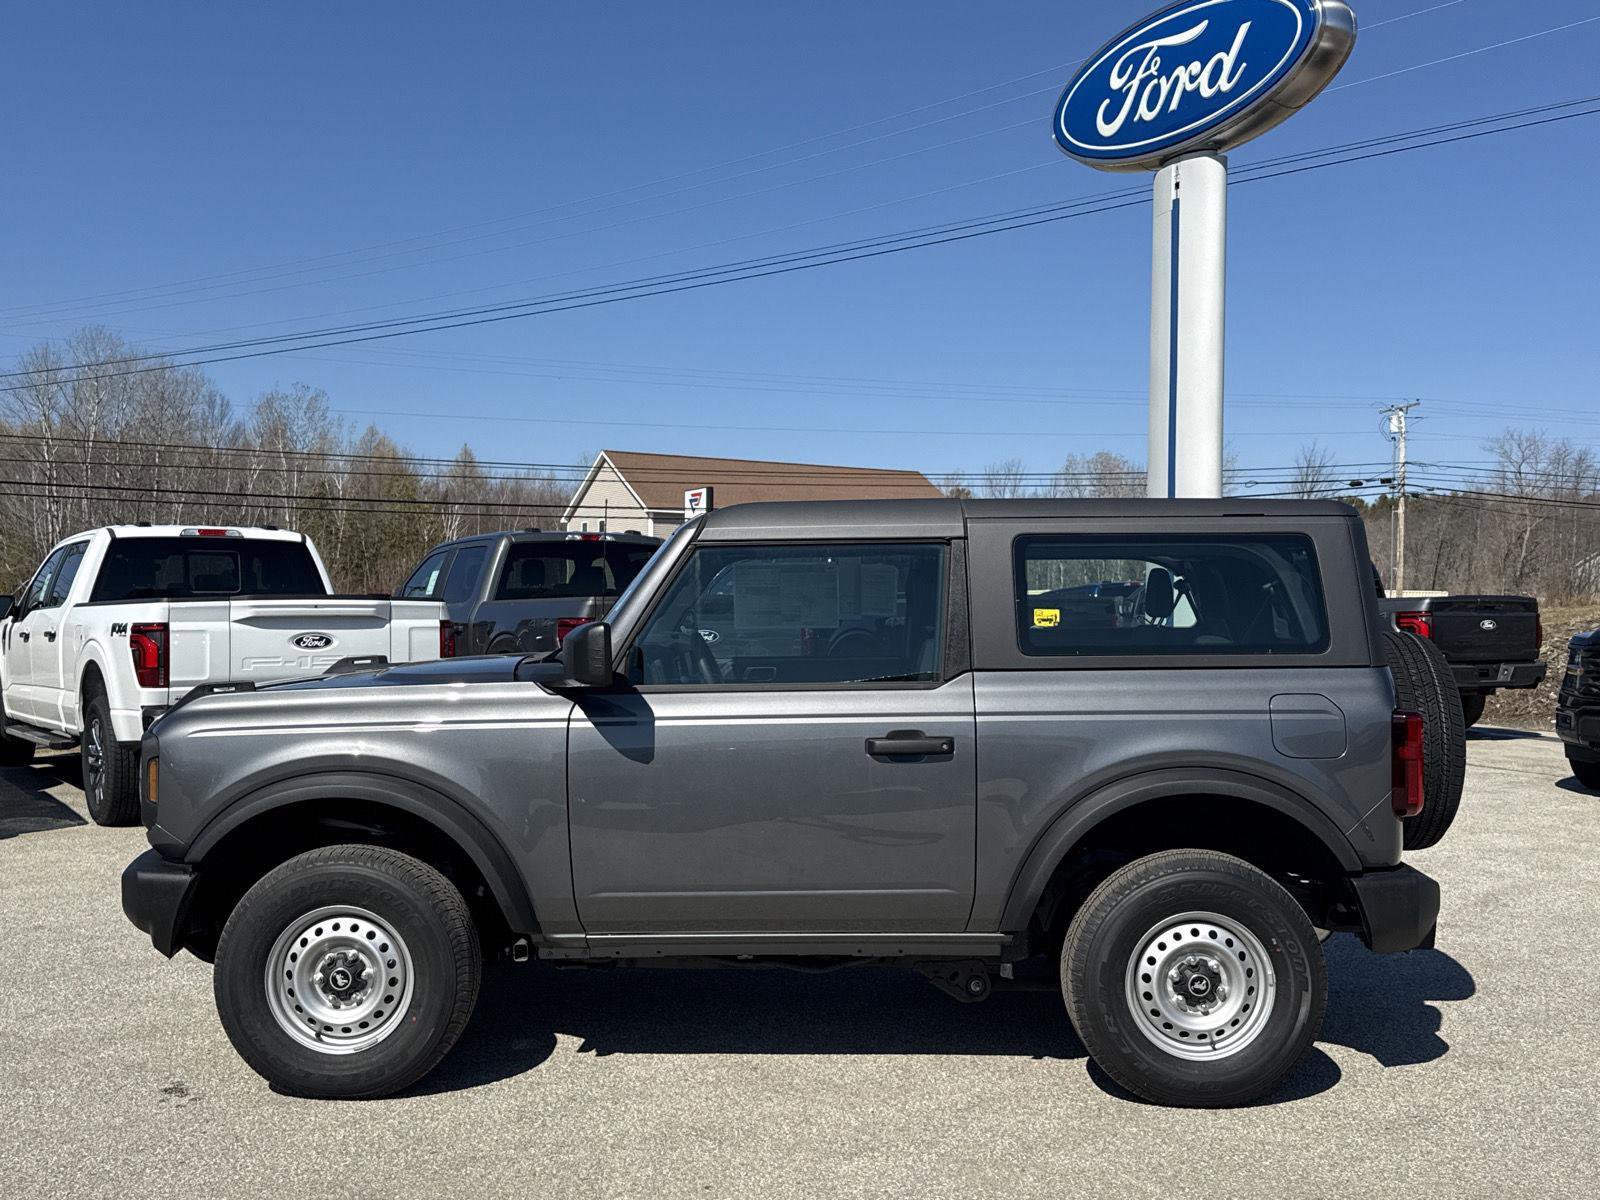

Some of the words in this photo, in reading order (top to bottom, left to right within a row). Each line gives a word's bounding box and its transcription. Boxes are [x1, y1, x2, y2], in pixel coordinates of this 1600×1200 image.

[1096, 19, 1253, 137] Ford
[110, 622, 128, 637] FX4
[300, 636, 326, 647] Ford
[241, 655, 347, 671] F-15
